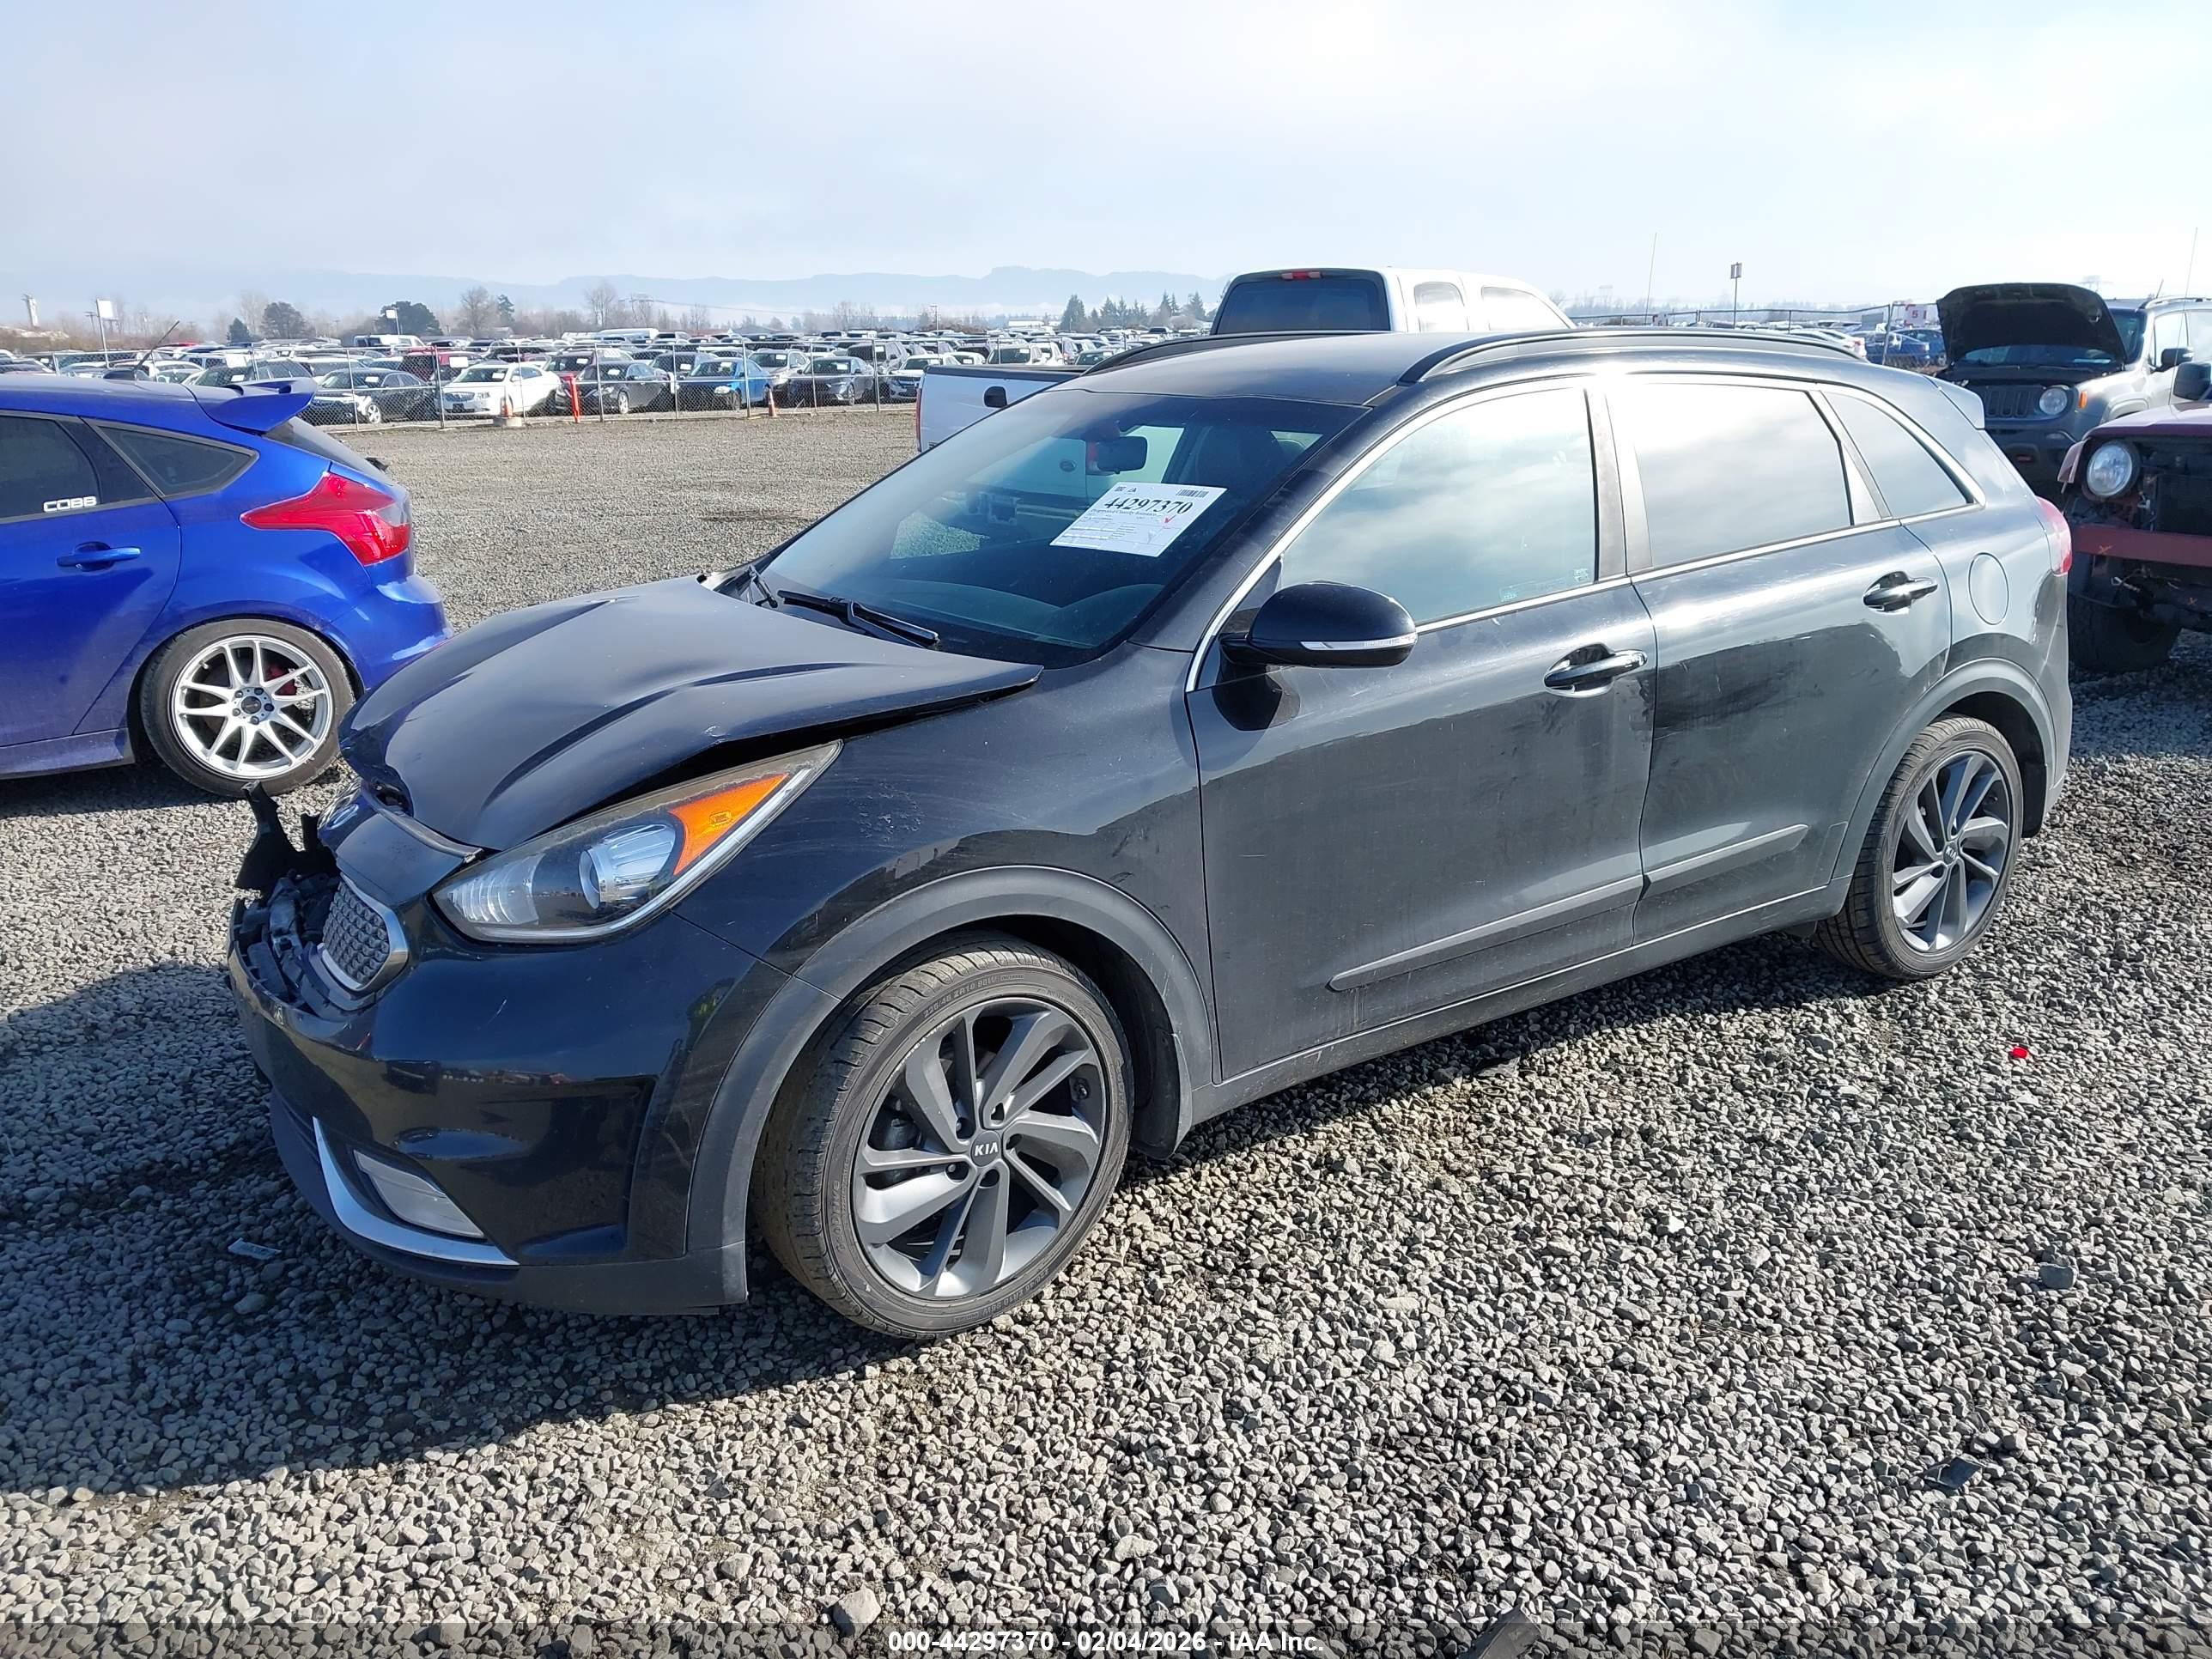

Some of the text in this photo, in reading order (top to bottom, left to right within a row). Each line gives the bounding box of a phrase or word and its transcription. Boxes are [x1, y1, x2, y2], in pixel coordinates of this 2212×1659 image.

[43, 495, 97, 513] COBB
[1104, 497, 1194, 514] 44297370
[1946, 846, 1957, 860] KIA
[974, 1141, 999, 1157] KIA
